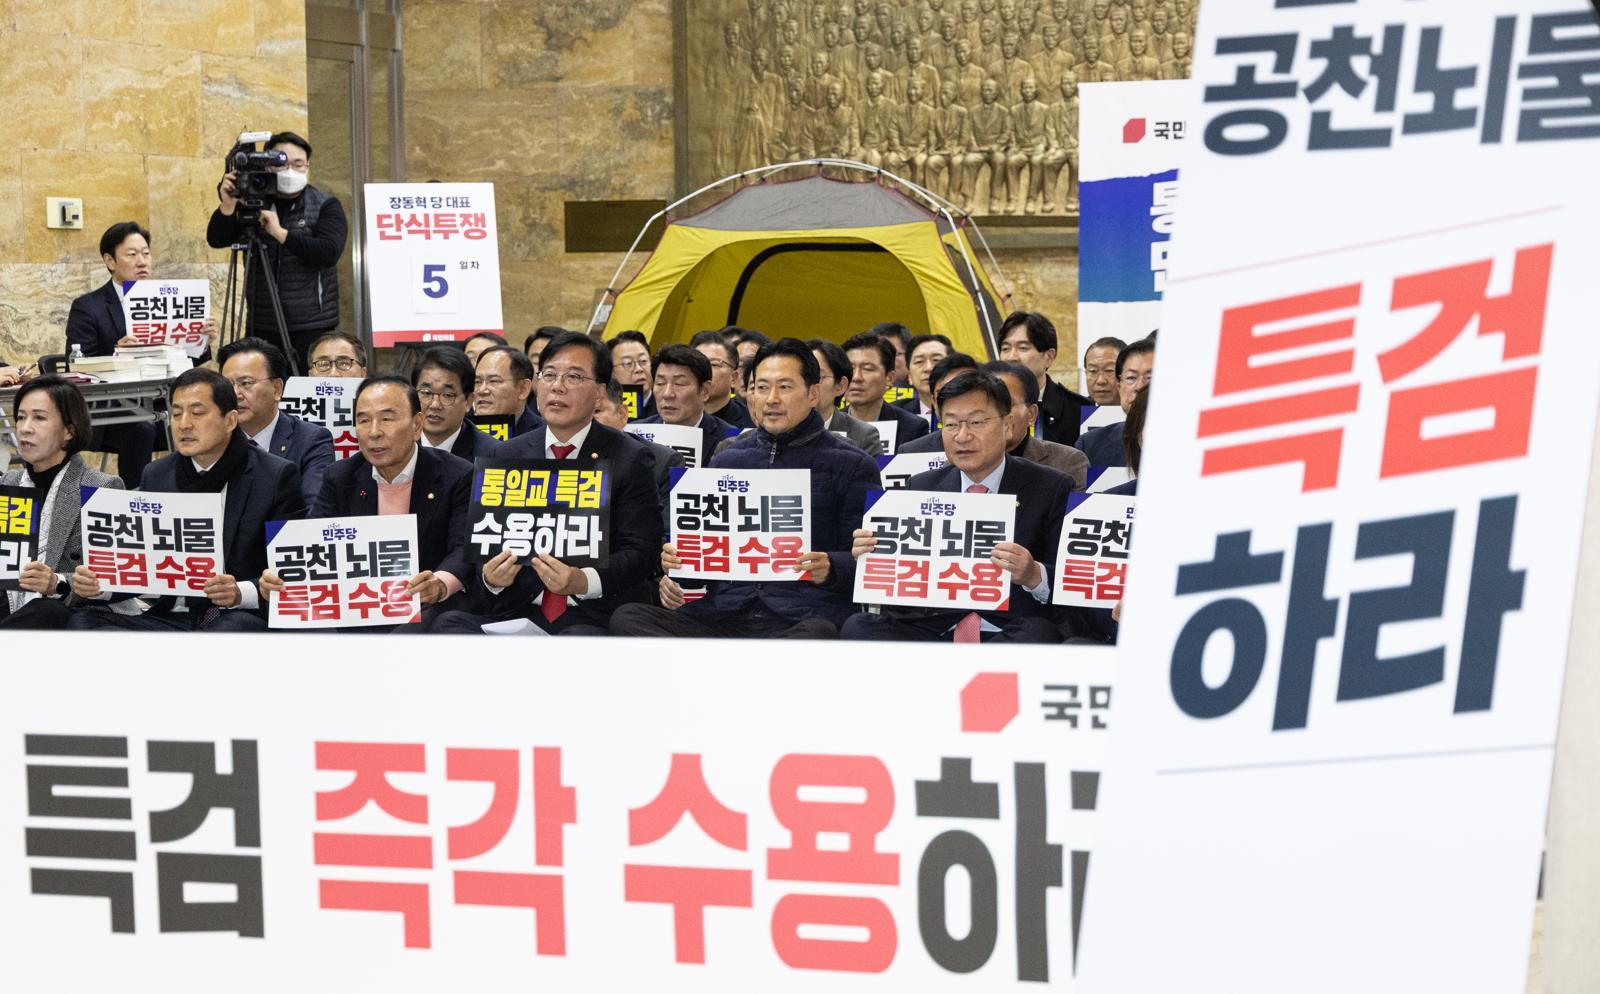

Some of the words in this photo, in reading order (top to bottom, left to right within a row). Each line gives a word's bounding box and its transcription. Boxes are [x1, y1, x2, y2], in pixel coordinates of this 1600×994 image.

[389, 196, 427, 210] 장동혁
[430, 196, 443, 210] 당
[446, 196, 471, 209] 대표
[376, 212, 488, 241] 단식투쟁
[159, 286, 179, 295] 민주당
[422, 263, 449, 299] 5
[129, 296, 168, 321] 공천
[171, 296, 206, 320] 뇌물
[132, 322, 167, 346] 특검
[170, 321, 203, 346] 수용
[1196, 240, 1556, 494] 특검
[315, 385, 345, 396] 민주당
[480, 468, 551, 507] 통일교
[554, 469, 603, 509] 특검
[717, 479, 750, 493] 민주당
[129, 501, 163, 514] 민주당
[676, 493, 730, 532] 공천
[737, 495, 804, 533] 뇌물
[920, 502, 957, 516] 민주당
[87, 510, 146, 550] 공천
[152, 517, 215, 553] 뇌물
[322, 527, 358, 541] 민주당
[470, 512, 603, 559] 수용하라
[870, 516, 933, 557] 공천
[938, 520, 1007, 558] 뇌물
[1067, 517, 1131, 559] 공천
[88, 550, 149, 588] 특검
[155, 555, 217, 591] 수용
[275, 543, 339, 583] 공천
[346, 539, 412, 578] 뇌물
[676, 533, 730, 573] 특검
[738, 535, 804, 574] 수용
[862, 557, 931, 599] 특검
[937, 559, 1004, 602] 수용
[1062, 558, 1127, 600] 특검
[277, 584, 341, 622] 특검
[348, 579, 414, 620] 수용
[1169, 493, 1527, 732] 하라
[24, 733, 266, 939] 특검
[313, 740, 577, 956] 즉각
